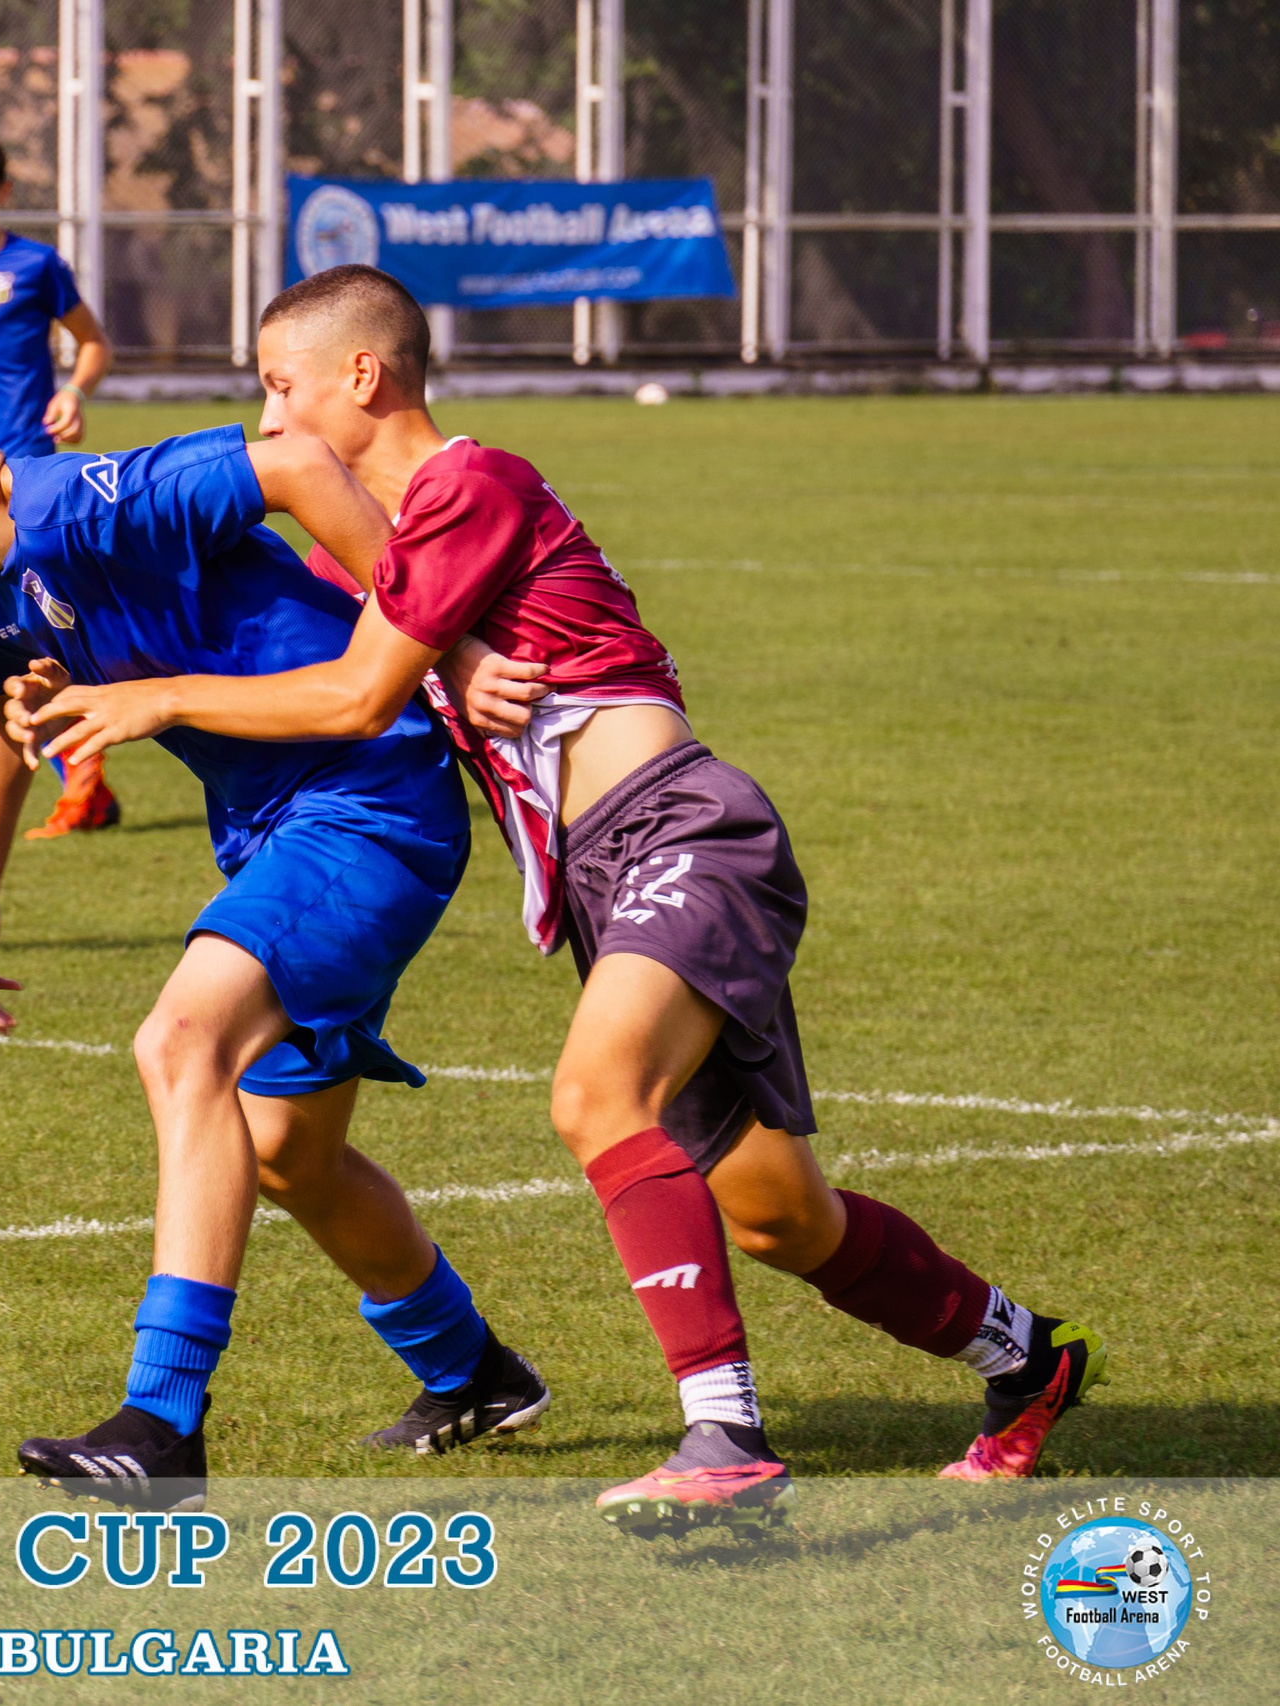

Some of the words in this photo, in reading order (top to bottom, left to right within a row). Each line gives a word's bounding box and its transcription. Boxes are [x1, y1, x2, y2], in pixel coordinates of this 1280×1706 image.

[380, 202, 469, 246] West
[472, 202, 606, 246] Football
[607, 203, 715, 246] Arena
